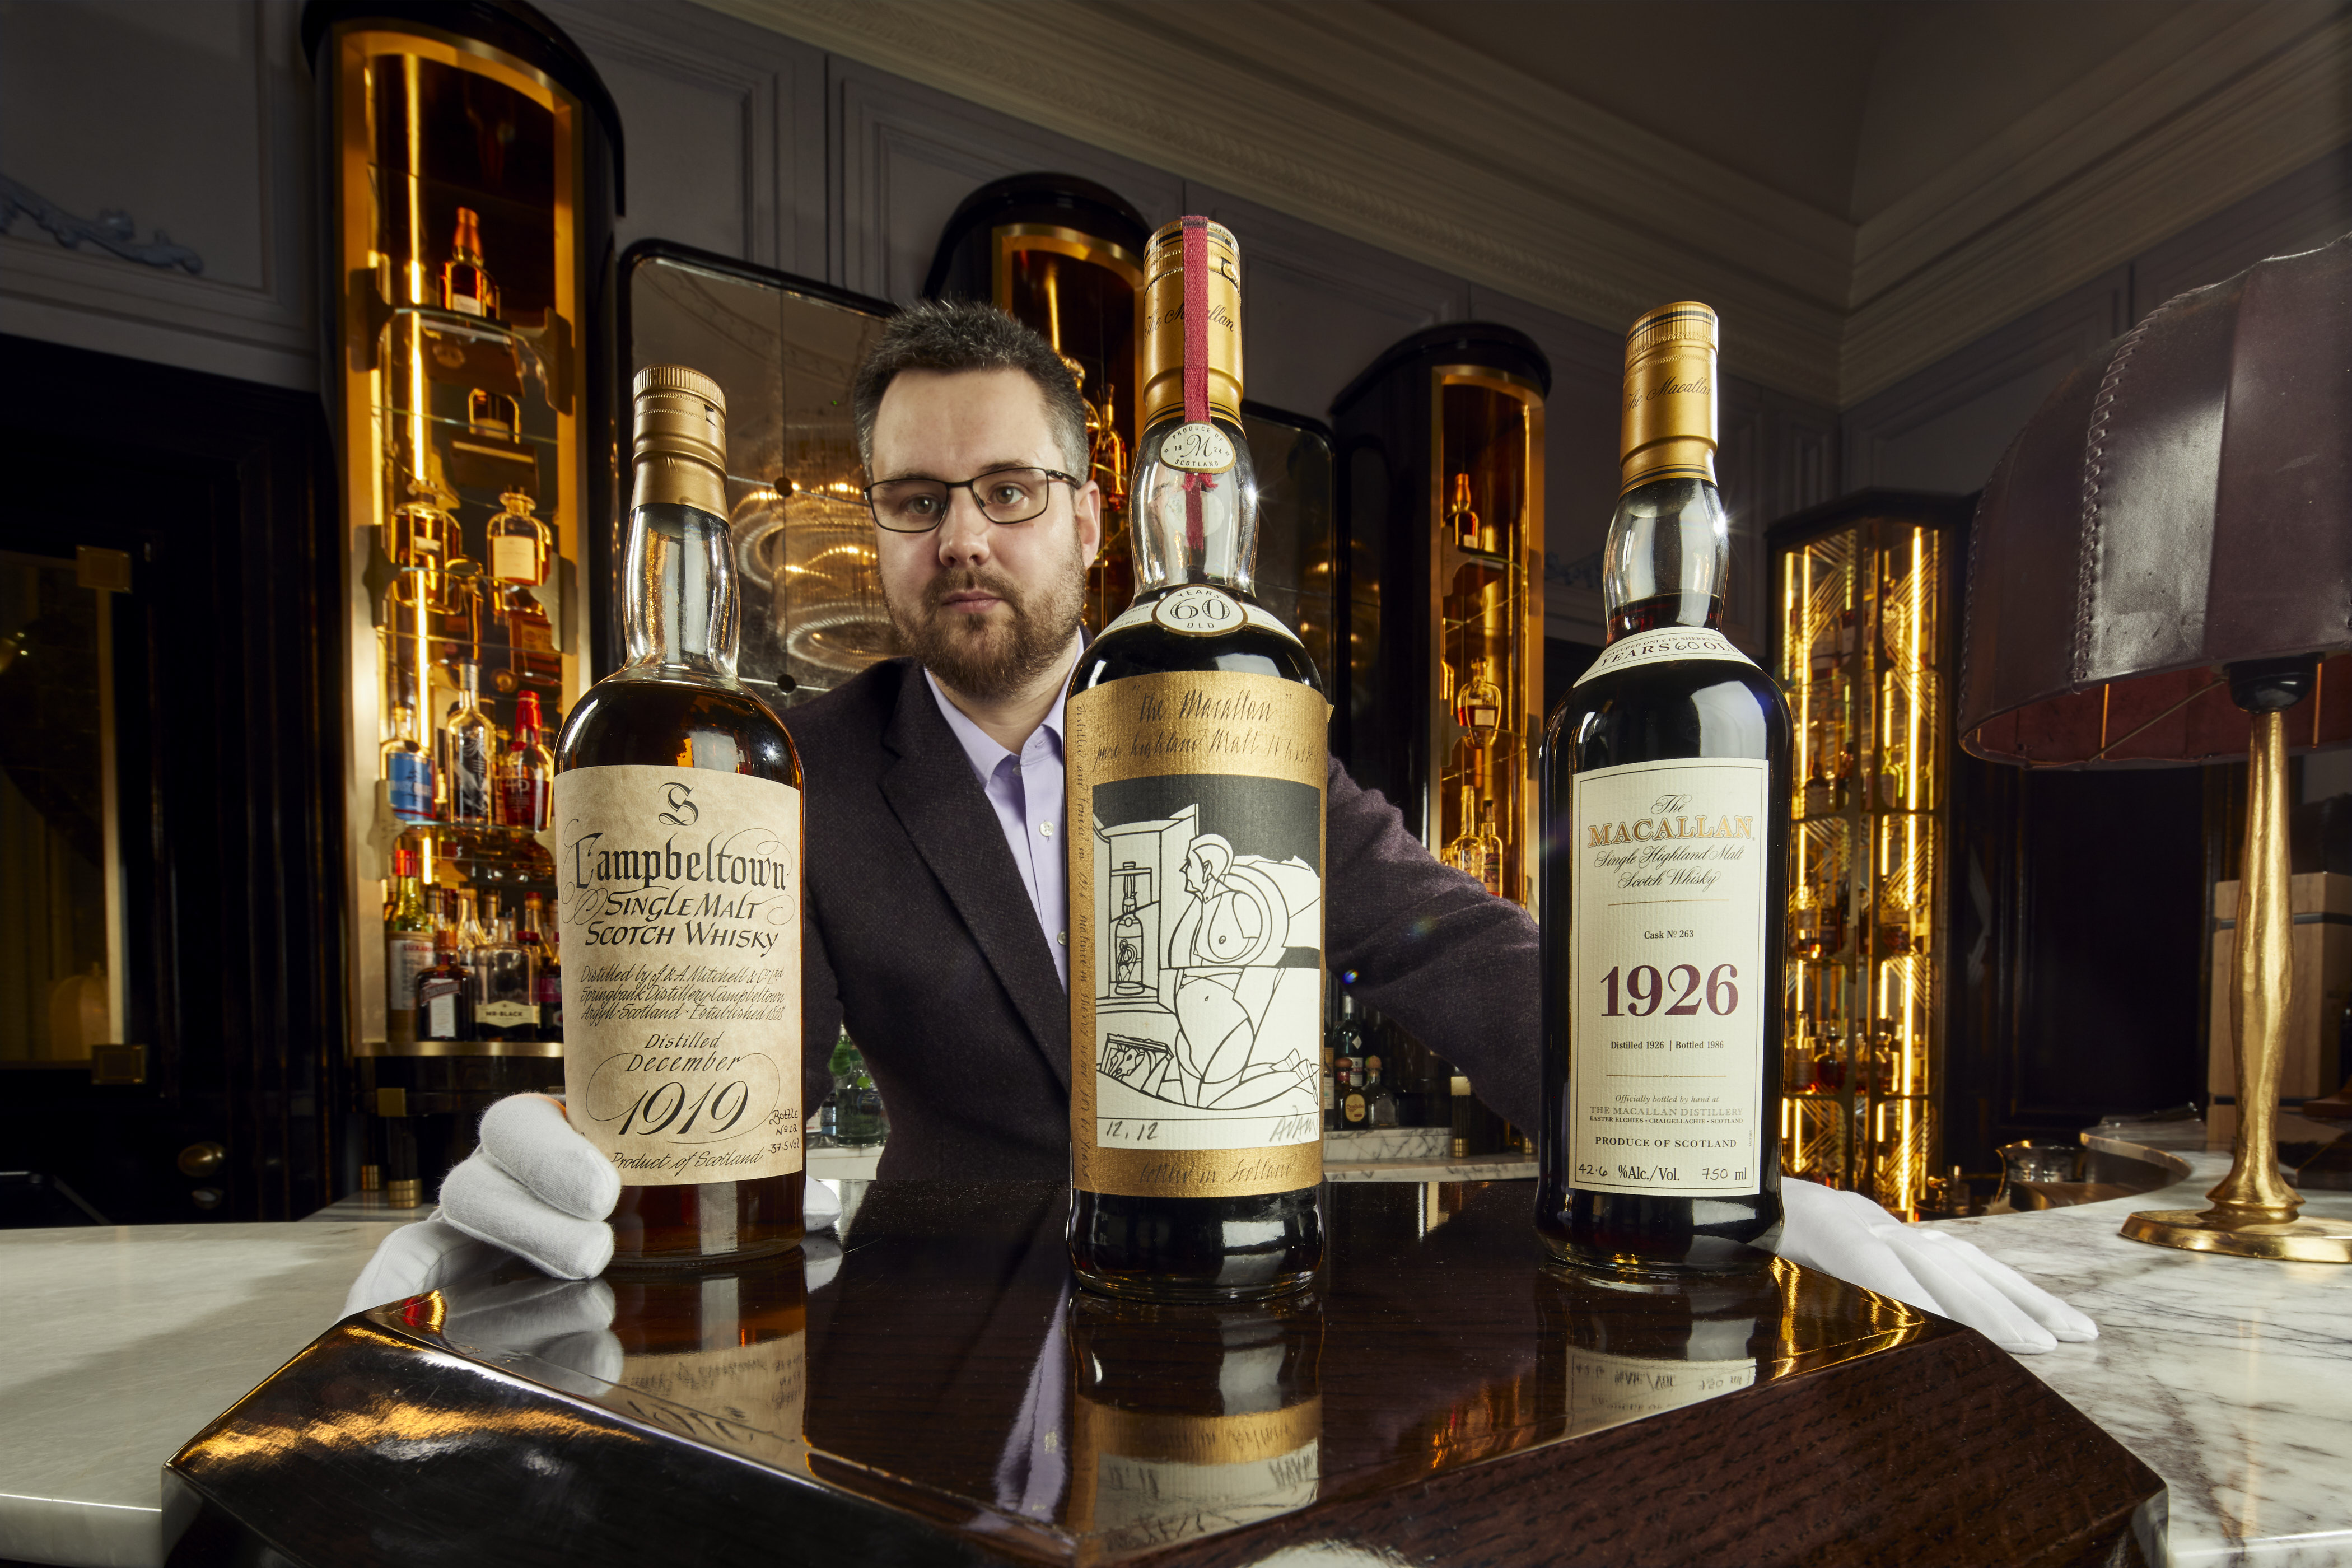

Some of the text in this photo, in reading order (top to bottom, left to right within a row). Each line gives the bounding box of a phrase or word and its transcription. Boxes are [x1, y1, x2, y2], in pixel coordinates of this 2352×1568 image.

[1165, 303, 1234, 332] Mllan
[1623, 388, 1643, 418] The
[1173, 426, 1224, 442] PRODUCE OF
[1180, 434, 1213, 458] M
[1175, 459, 1219, 467] SCOTLAND
[1177, 590, 1221, 599] YEARS
[1170, 598, 1230, 620] 60
[1601, 643, 1670, 666] YEARS
[1675, 641, 1700, 650] 60
[1607, 643, 1641, 657] MATURED
[1179, 689, 1277, 722] Macallan
[1209, 728, 1263, 754] Malt
[658, 782, 699, 826] S
[1651, 794, 1692, 814] The
[1587, 815, 1753, 848] MACALLAN
[572, 830, 788, 890] Campbeltown
[1594, 843, 1746, 874] Single Highland Malt
[1618, 866, 1721, 892] Scotch Whisky
[605, 886, 765, 922] SINGLE MALT
[585, 921, 779, 958] SCOTCH WHISKY
[1080, 914, 1091, 968] matured
[1644, 930, 1664, 939] Cask
[1679, 930, 1694, 938] 263
[580, 963, 636, 982] Distilled
[635, 964, 650, 990] by
[664, 967, 676, 982] &
[673, 965, 690, 982] A.
[687, 965, 750, 983] Mitchell
[746, 970, 758, 983] &
[580, 984, 785, 1009] Springbank Distillery Campbeltown
[1600, 963, 1738, 1017] 1926
[581, 1002, 786, 1026] Argyll Scotland Established 1828
[645, 1031, 725, 1049] Distilled
[1611, 1041, 1642, 1049] Distilled
[1646, 1041, 1664, 1049] 1926
[1676, 1041, 1704, 1049] Bottled
[624, 1051, 743, 1072] December
[619, 1080, 748, 1135] 1919
[1590, 1106, 1743, 1116] THE MACALLAN DISTILLERY
[1615, 1094, 1651, 1104] Officially
[1679, 1096, 1689, 1105] by
[769, 1108, 799, 1125] Bottle
[1137, 1121, 1159, 1141] 12
[1595, 1136, 1737, 1148] PRODUCE OF SCOTLAND
[612, 1147, 766, 1177] Product of Scotland
[1226, 1154, 1298, 1183] Scotland
[1618, 1164, 1681, 1181] %Alc./Vol.
[1702, 1168, 1729, 1180] 750
[1734, 1167, 1747, 1180] ml
